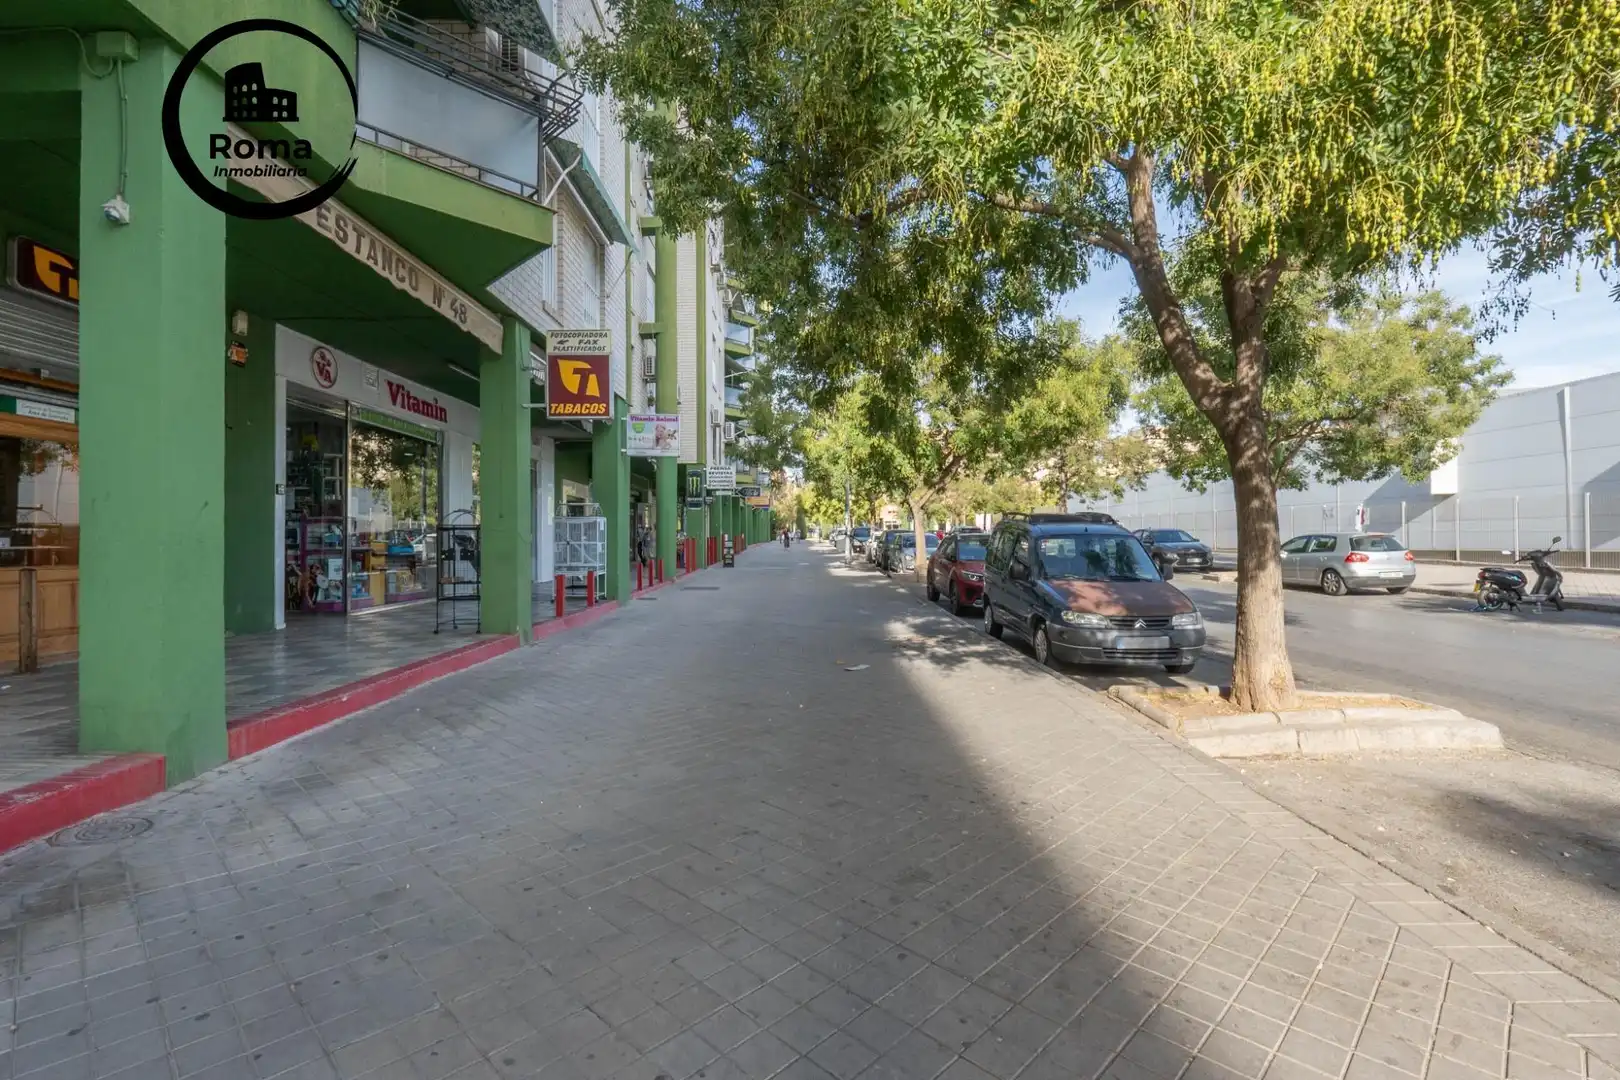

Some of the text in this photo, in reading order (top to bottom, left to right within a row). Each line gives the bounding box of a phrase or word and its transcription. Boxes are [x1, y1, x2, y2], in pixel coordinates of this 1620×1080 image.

[316, 205, 420, 292] ESTANCO
[450, 298, 468, 324] 48
[385, 379, 448, 423] Vitamin
[550, 403, 607, 415] TABACOS
